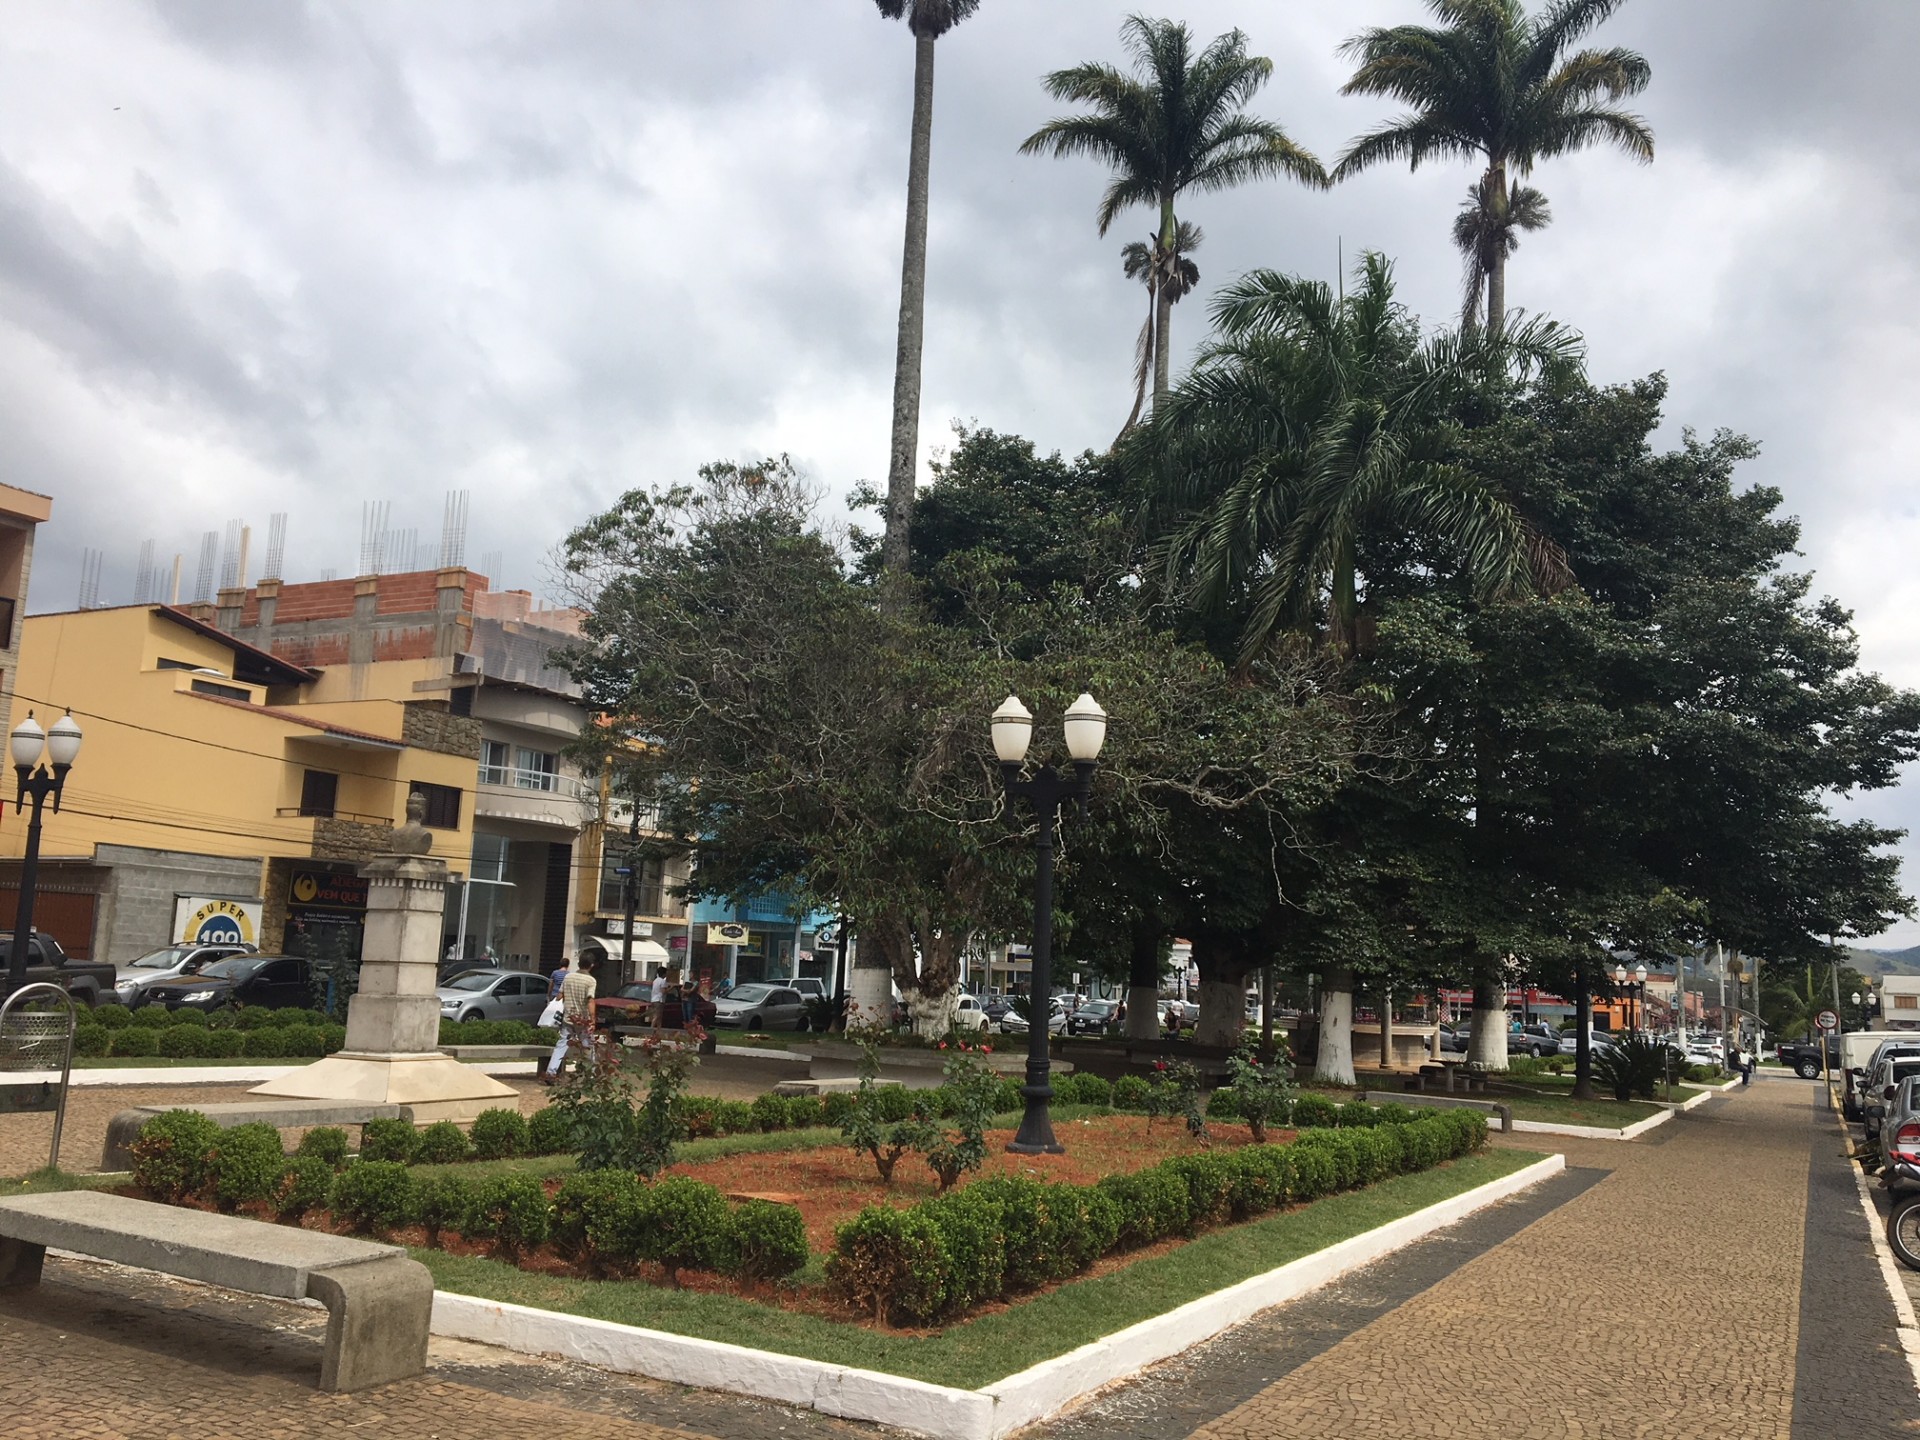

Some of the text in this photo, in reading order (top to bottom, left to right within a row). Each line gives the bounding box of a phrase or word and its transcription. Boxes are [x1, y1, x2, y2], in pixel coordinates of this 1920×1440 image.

[318, 889, 338, 899] VEM
[341, 891, 360, 903] QUE
[197, 902, 245, 921] SUPER
[200, 930, 239, 943] 100
